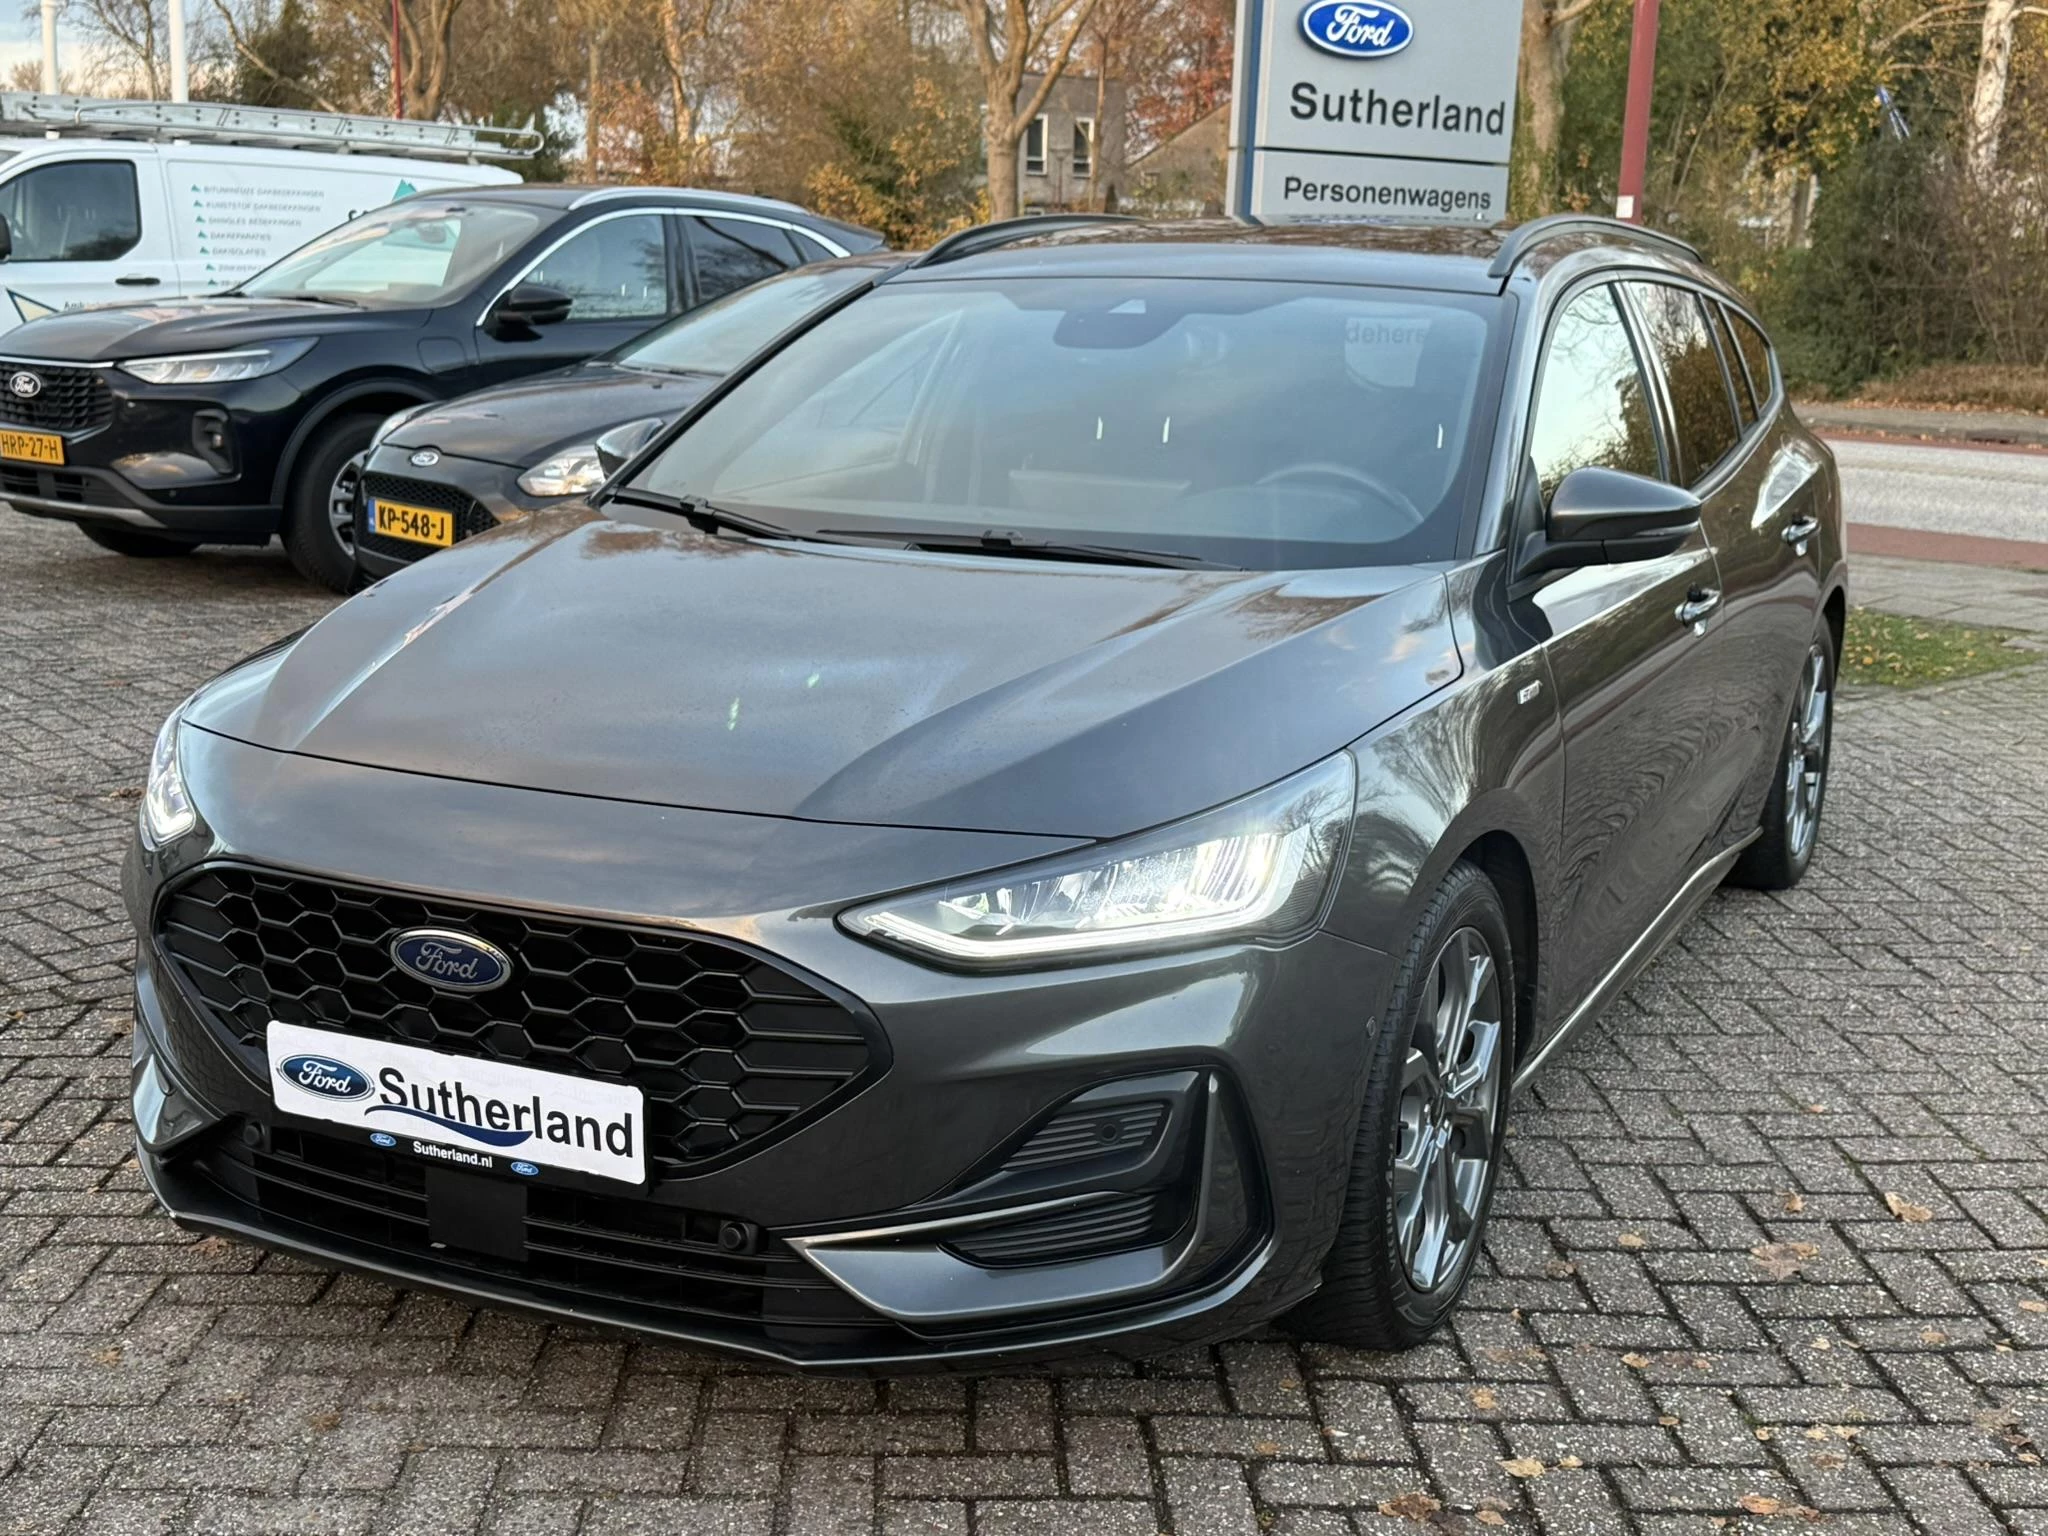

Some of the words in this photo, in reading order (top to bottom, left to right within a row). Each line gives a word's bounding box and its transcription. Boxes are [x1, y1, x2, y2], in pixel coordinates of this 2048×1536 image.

[1326, 5, 1396, 47] Ford
[1290, 82, 1505, 135] Sutherland
[1284, 177, 1491, 212] Personenwagens
[1, 434, 59, 460] HRP-27-H
[379, 505, 444, 540] KP-548-J
[415, 941, 478, 980] Ford
[299, 1060, 352, 1094] Ford
[379, 1067, 633, 1158] Sutherland
[413, 1140, 492, 1168] Sutherland.nl
